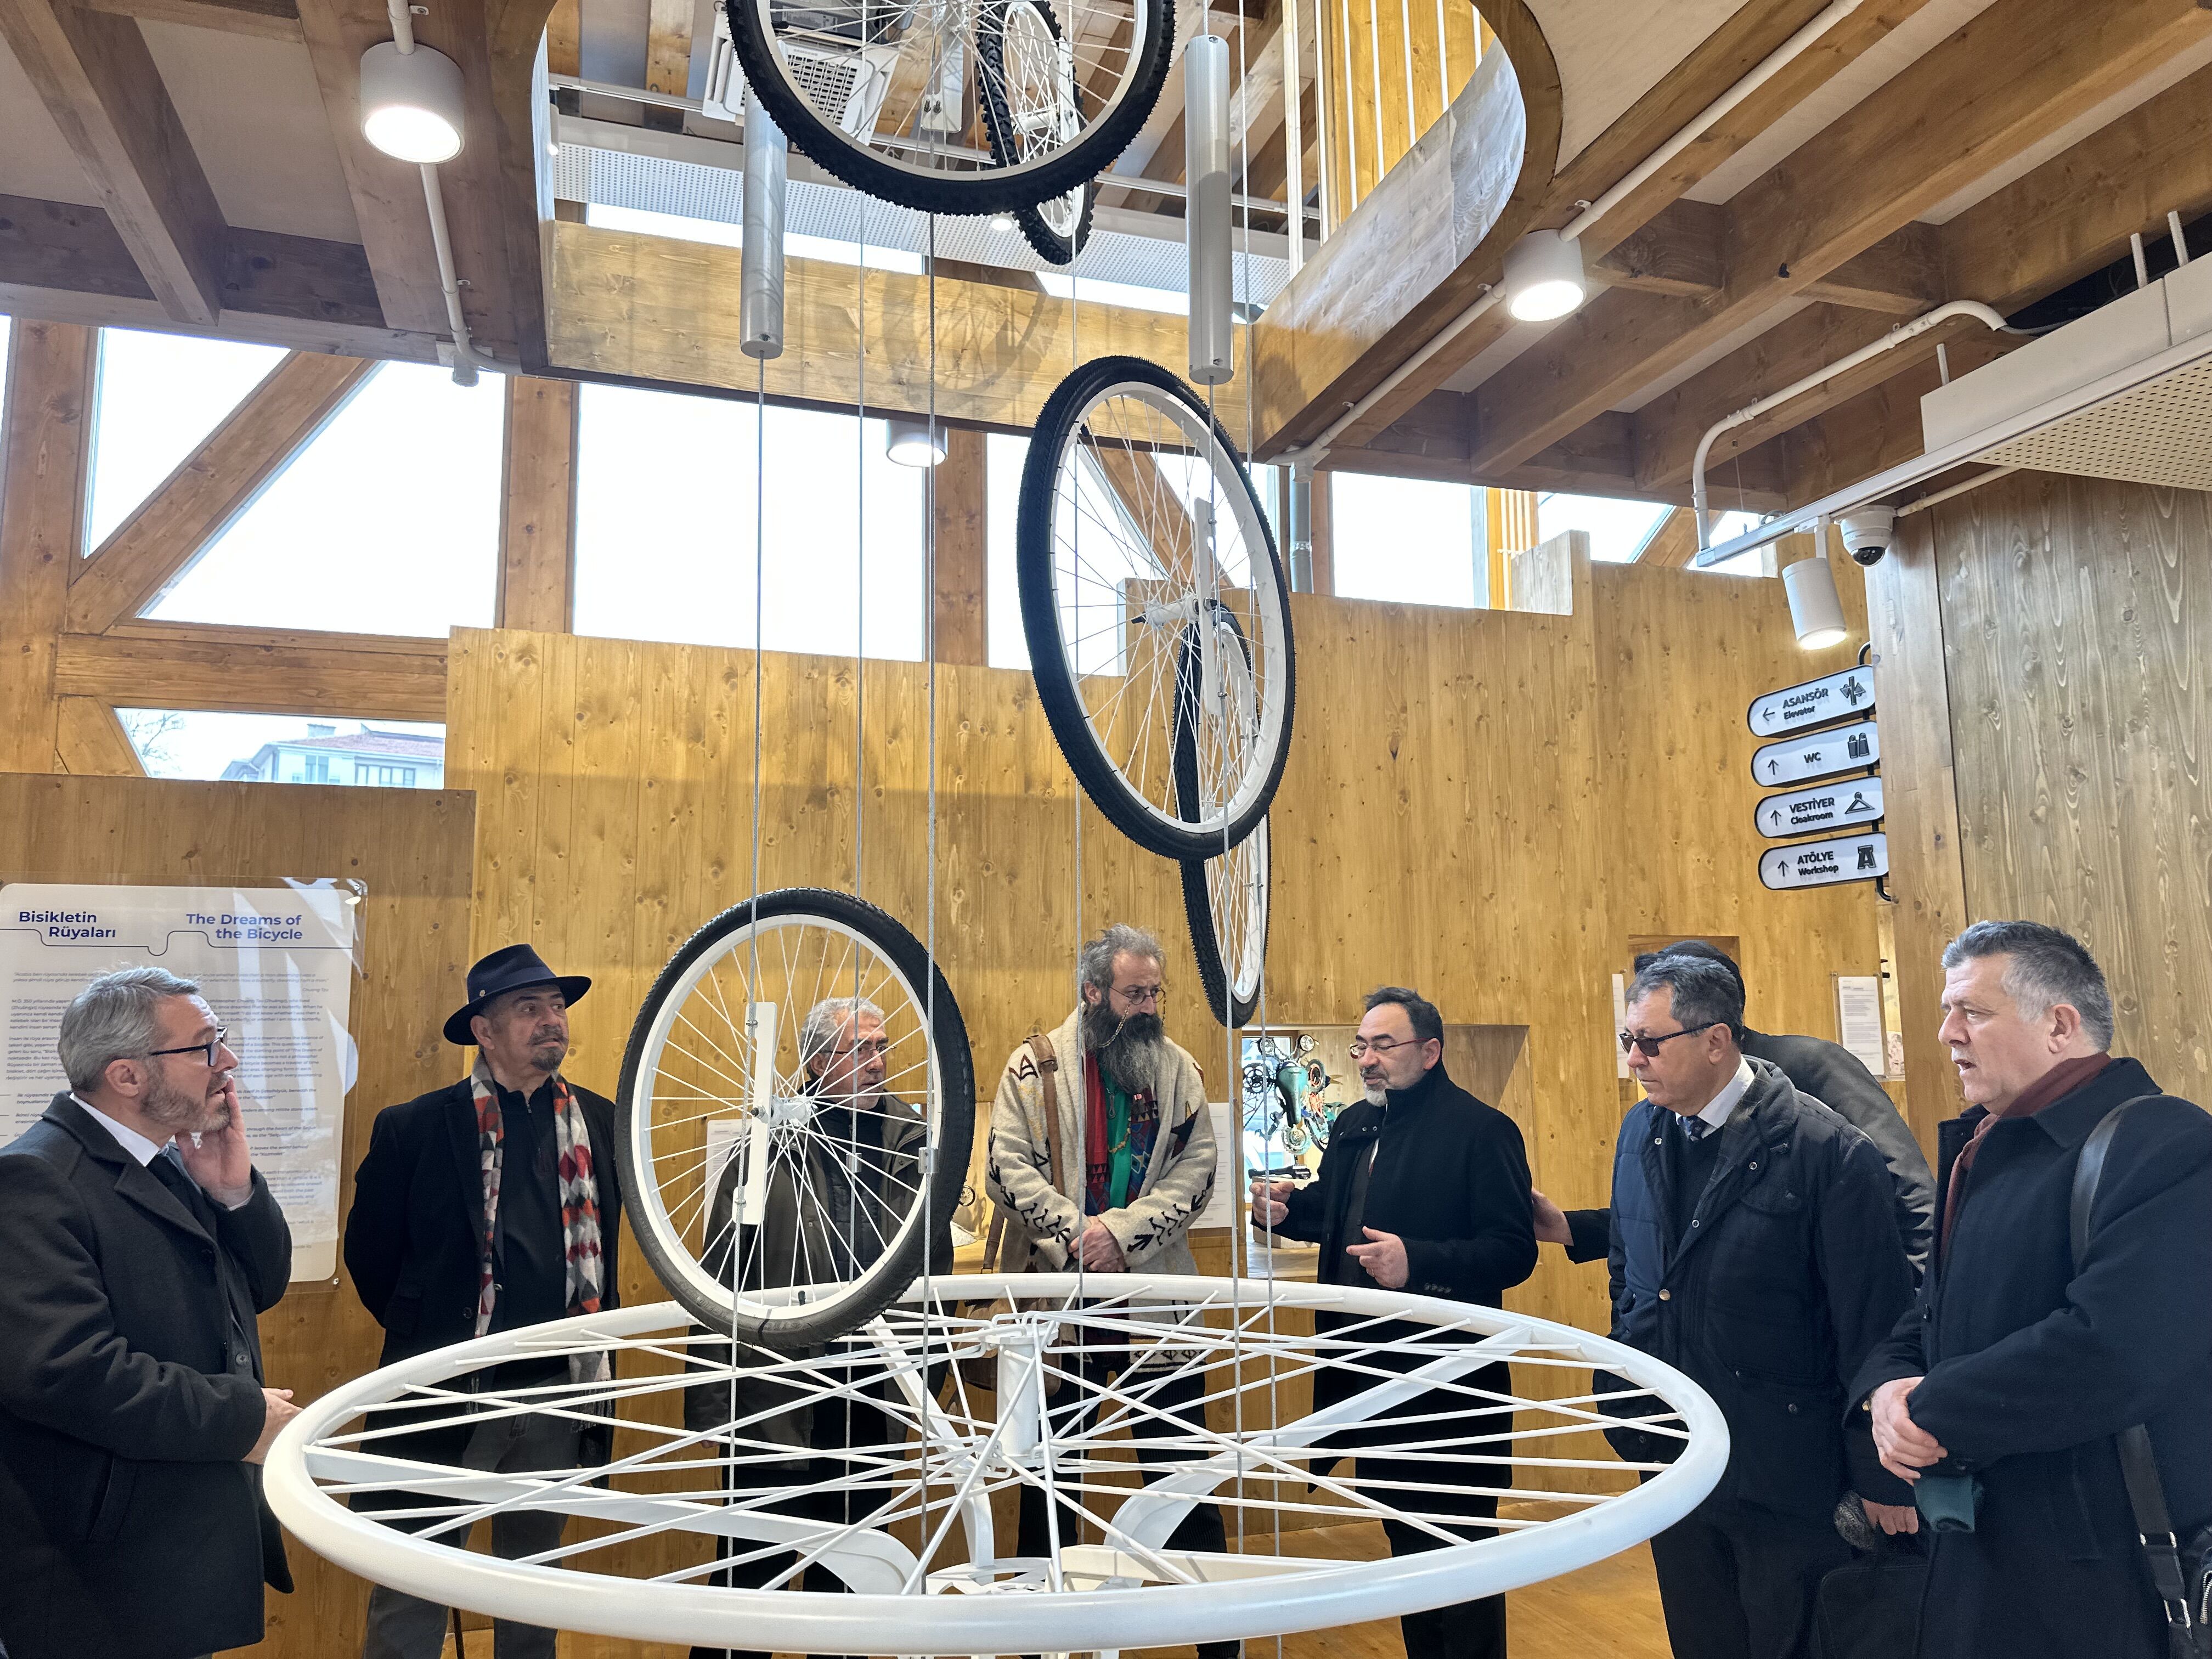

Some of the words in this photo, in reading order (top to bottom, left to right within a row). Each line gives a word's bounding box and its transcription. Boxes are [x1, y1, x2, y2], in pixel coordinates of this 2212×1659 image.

[1782, 687, 1829, 709] ASANSÖR
[1784, 705, 1815, 720] Elevator
[1804, 752, 1821, 764] WC
[1789, 798, 1835, 814] VESTİYER
[1791, 811, 1833, 825] Cloakroom
[1797, 851, 1834, 865] ATÖLYE
[1798, 865, 1839, 876] Workshop
[19, 911, 97, 923] Bisikletin
[186, 913, 216, 924] The
[221, 914, 281, 925] Dreams
[286, 915, 302, 926] of
[49, 926, 116, 940] Rüyaları
[216, 928, 242, 939] the
[247, 928, 303, 941] Bicycle
